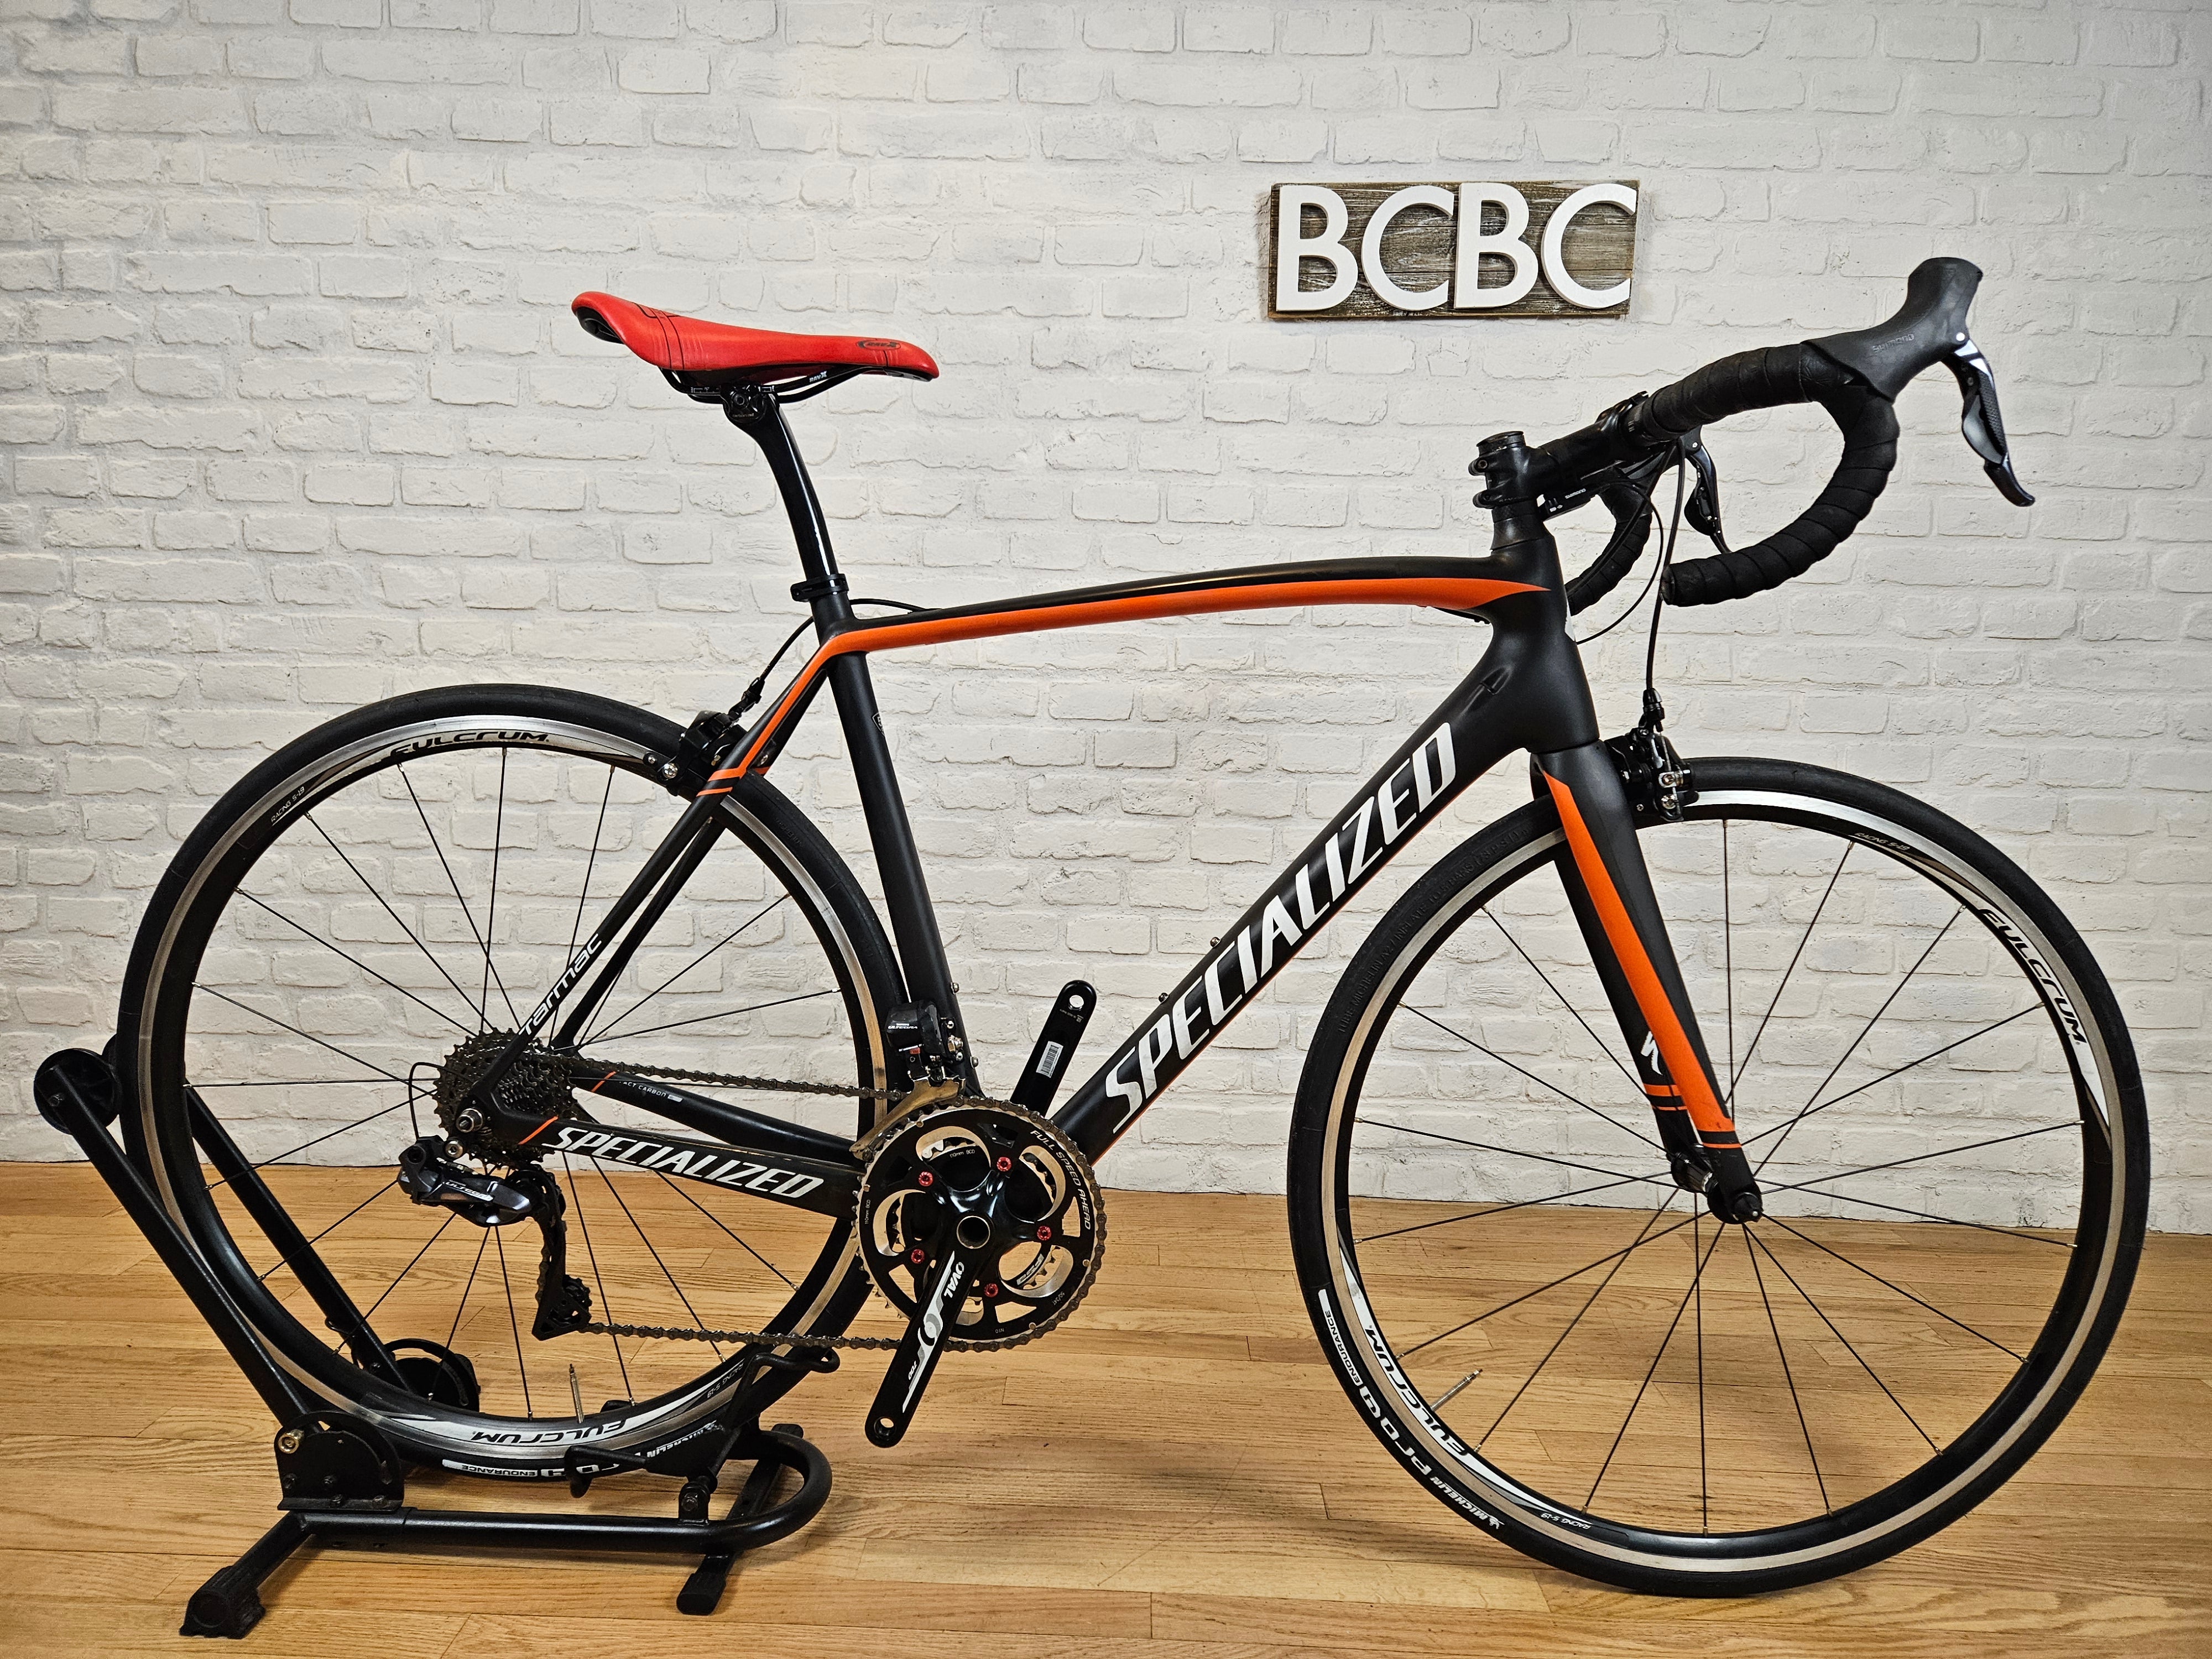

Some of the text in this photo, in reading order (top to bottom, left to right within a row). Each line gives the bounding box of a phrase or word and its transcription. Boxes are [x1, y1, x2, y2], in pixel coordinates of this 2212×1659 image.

[1276, 183, 1636, 311] BCBC
[809, 371, 827, 383] RAVX
[390, 731, 549, 757] FULCRUM
[271, 800, 291, 822] RACING
[1105, 722, 1457, 1134] SPECIALIZED
[1979, 909, 2087, 1044] FULCRUM
[638, 1085, 666, 1097] CARBON
[541, 1126, 824, 1198] SPECIALIZED
[1030, 1130, 1091, 1230] FULL SPEED AHEAD
[943, 1261, 964, 1298] OVAL
[1324, 1310, 1360, 1384] ENDURANCE
[1365, 1328, 1468, 1456] FULCRUM
[472, 1419, 627, 1444] FULCRUM
[461, 1464, 536, 1477] ENDURANCE
[1430, 1476, 1489, 1520] MICHELIN
